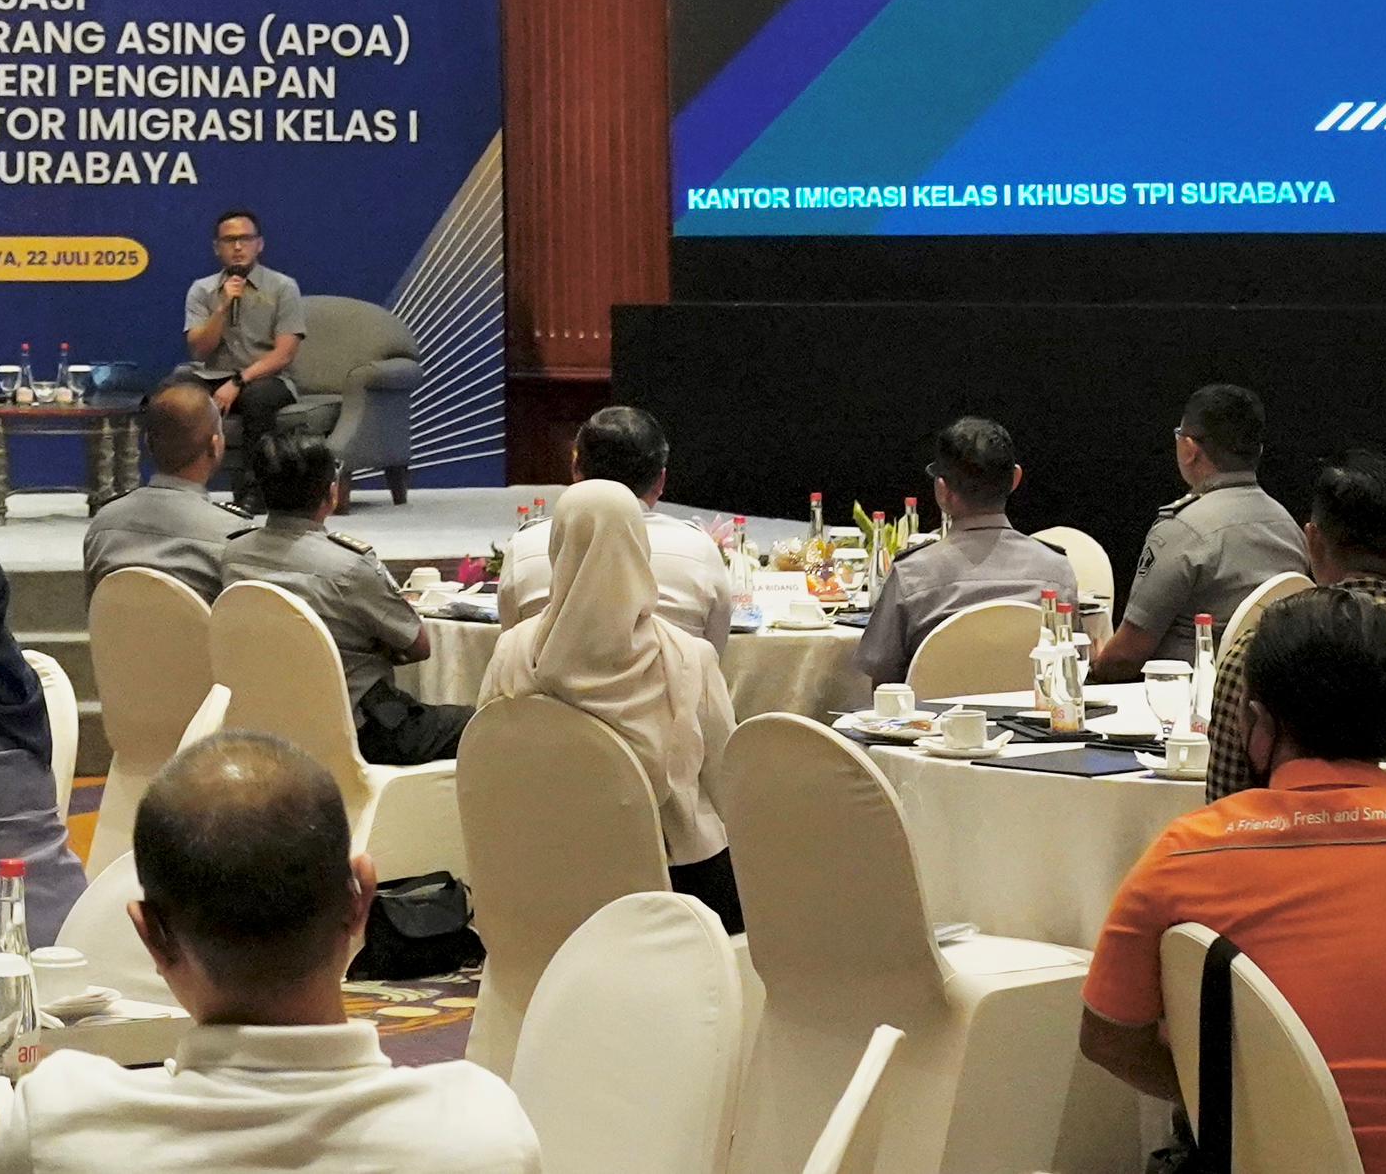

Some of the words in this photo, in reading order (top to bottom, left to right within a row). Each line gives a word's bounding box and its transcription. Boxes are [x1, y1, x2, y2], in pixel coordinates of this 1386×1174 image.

[116, 21, 246, 55] ASING
[259, 13, 410, 64] (APOA)
[69, 63, 336, 98] PENGINAPAN
[78, 107, 263, 142] IMIGRASI
[276, 108, 397, 143] KELAS
[409, 110, 418, 143] I
[687, 186, 791, 210] KANTOR
[795, 185, 907, 209] IMIGRASI
[912, 184, 998, 208] KELAS
[1003, 184, 1012, 207] I
[1017, 182, 1127, 206] KHUSUS
[1132, 182, 1175, 205] TPI
[1180, 180, 1336, 205] SURABAYA
[27, 250, 47, 266] 22
[53, 250, 90, 266] JULI
[95, 250, 139, 266] 2025
[1293, 811, 1331, 826] Fresh
[1333, 807, 1360, 823] and
